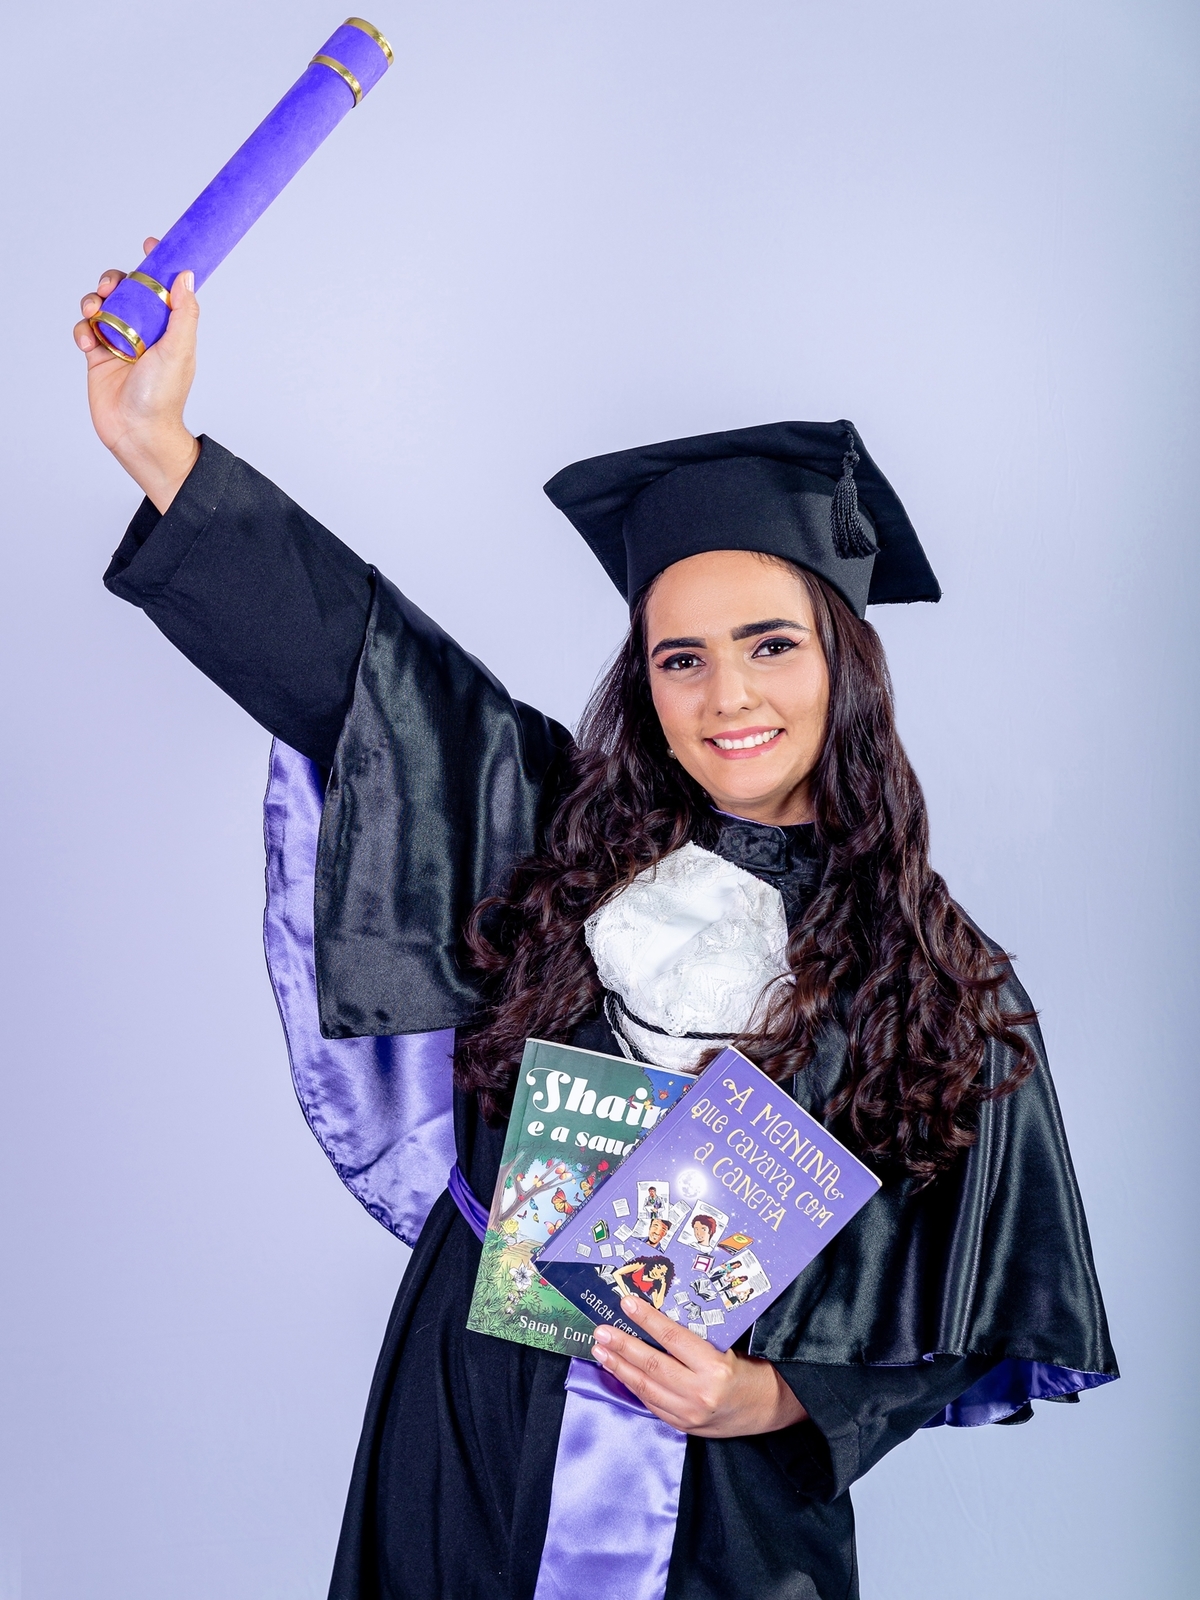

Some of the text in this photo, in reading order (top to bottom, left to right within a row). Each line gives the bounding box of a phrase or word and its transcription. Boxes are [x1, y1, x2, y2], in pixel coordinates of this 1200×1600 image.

[722, 1078, 755, 1115] A
[527, 1121, 545, 1136] e
[550, 1126, 570, 1143] a
[519, 1315, 598, 1345] Sarah Corr
